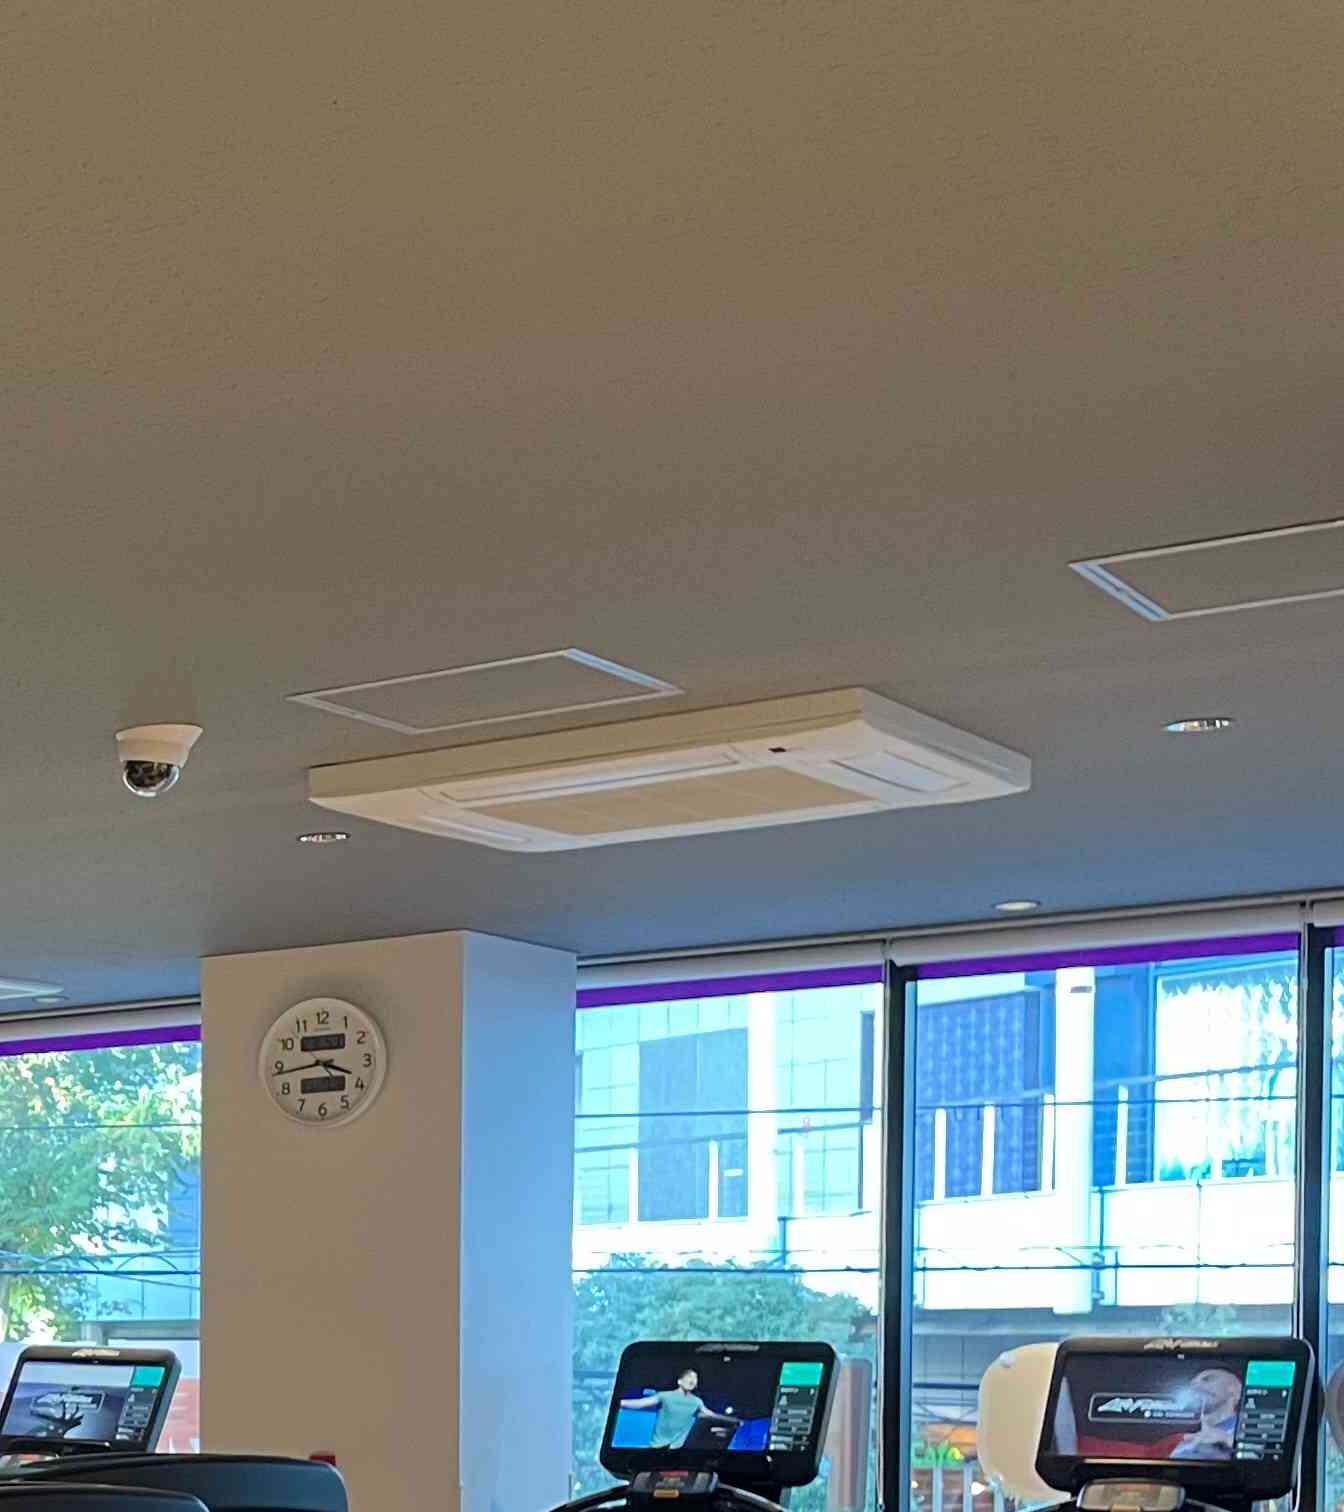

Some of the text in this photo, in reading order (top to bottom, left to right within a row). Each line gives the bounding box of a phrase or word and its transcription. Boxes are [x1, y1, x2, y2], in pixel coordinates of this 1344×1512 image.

[316, 1011, 329, 1025] 12
[296, 1019, 307, 1033] 11
[356, 1030, 366, 1044] 2
[281, 1038, 294, 1051] 10
[274, 1060, 284, 1074] 9
[363, 1053, 372, 1068] 3
[281, 1082, 290, 1095] 8
[355, 1077, 364, 1091] 4
[297, 1099, 306, 1112] 7
[318, 1102, 327, 1116] 6
[340, 1095, 350, 1109] 5
